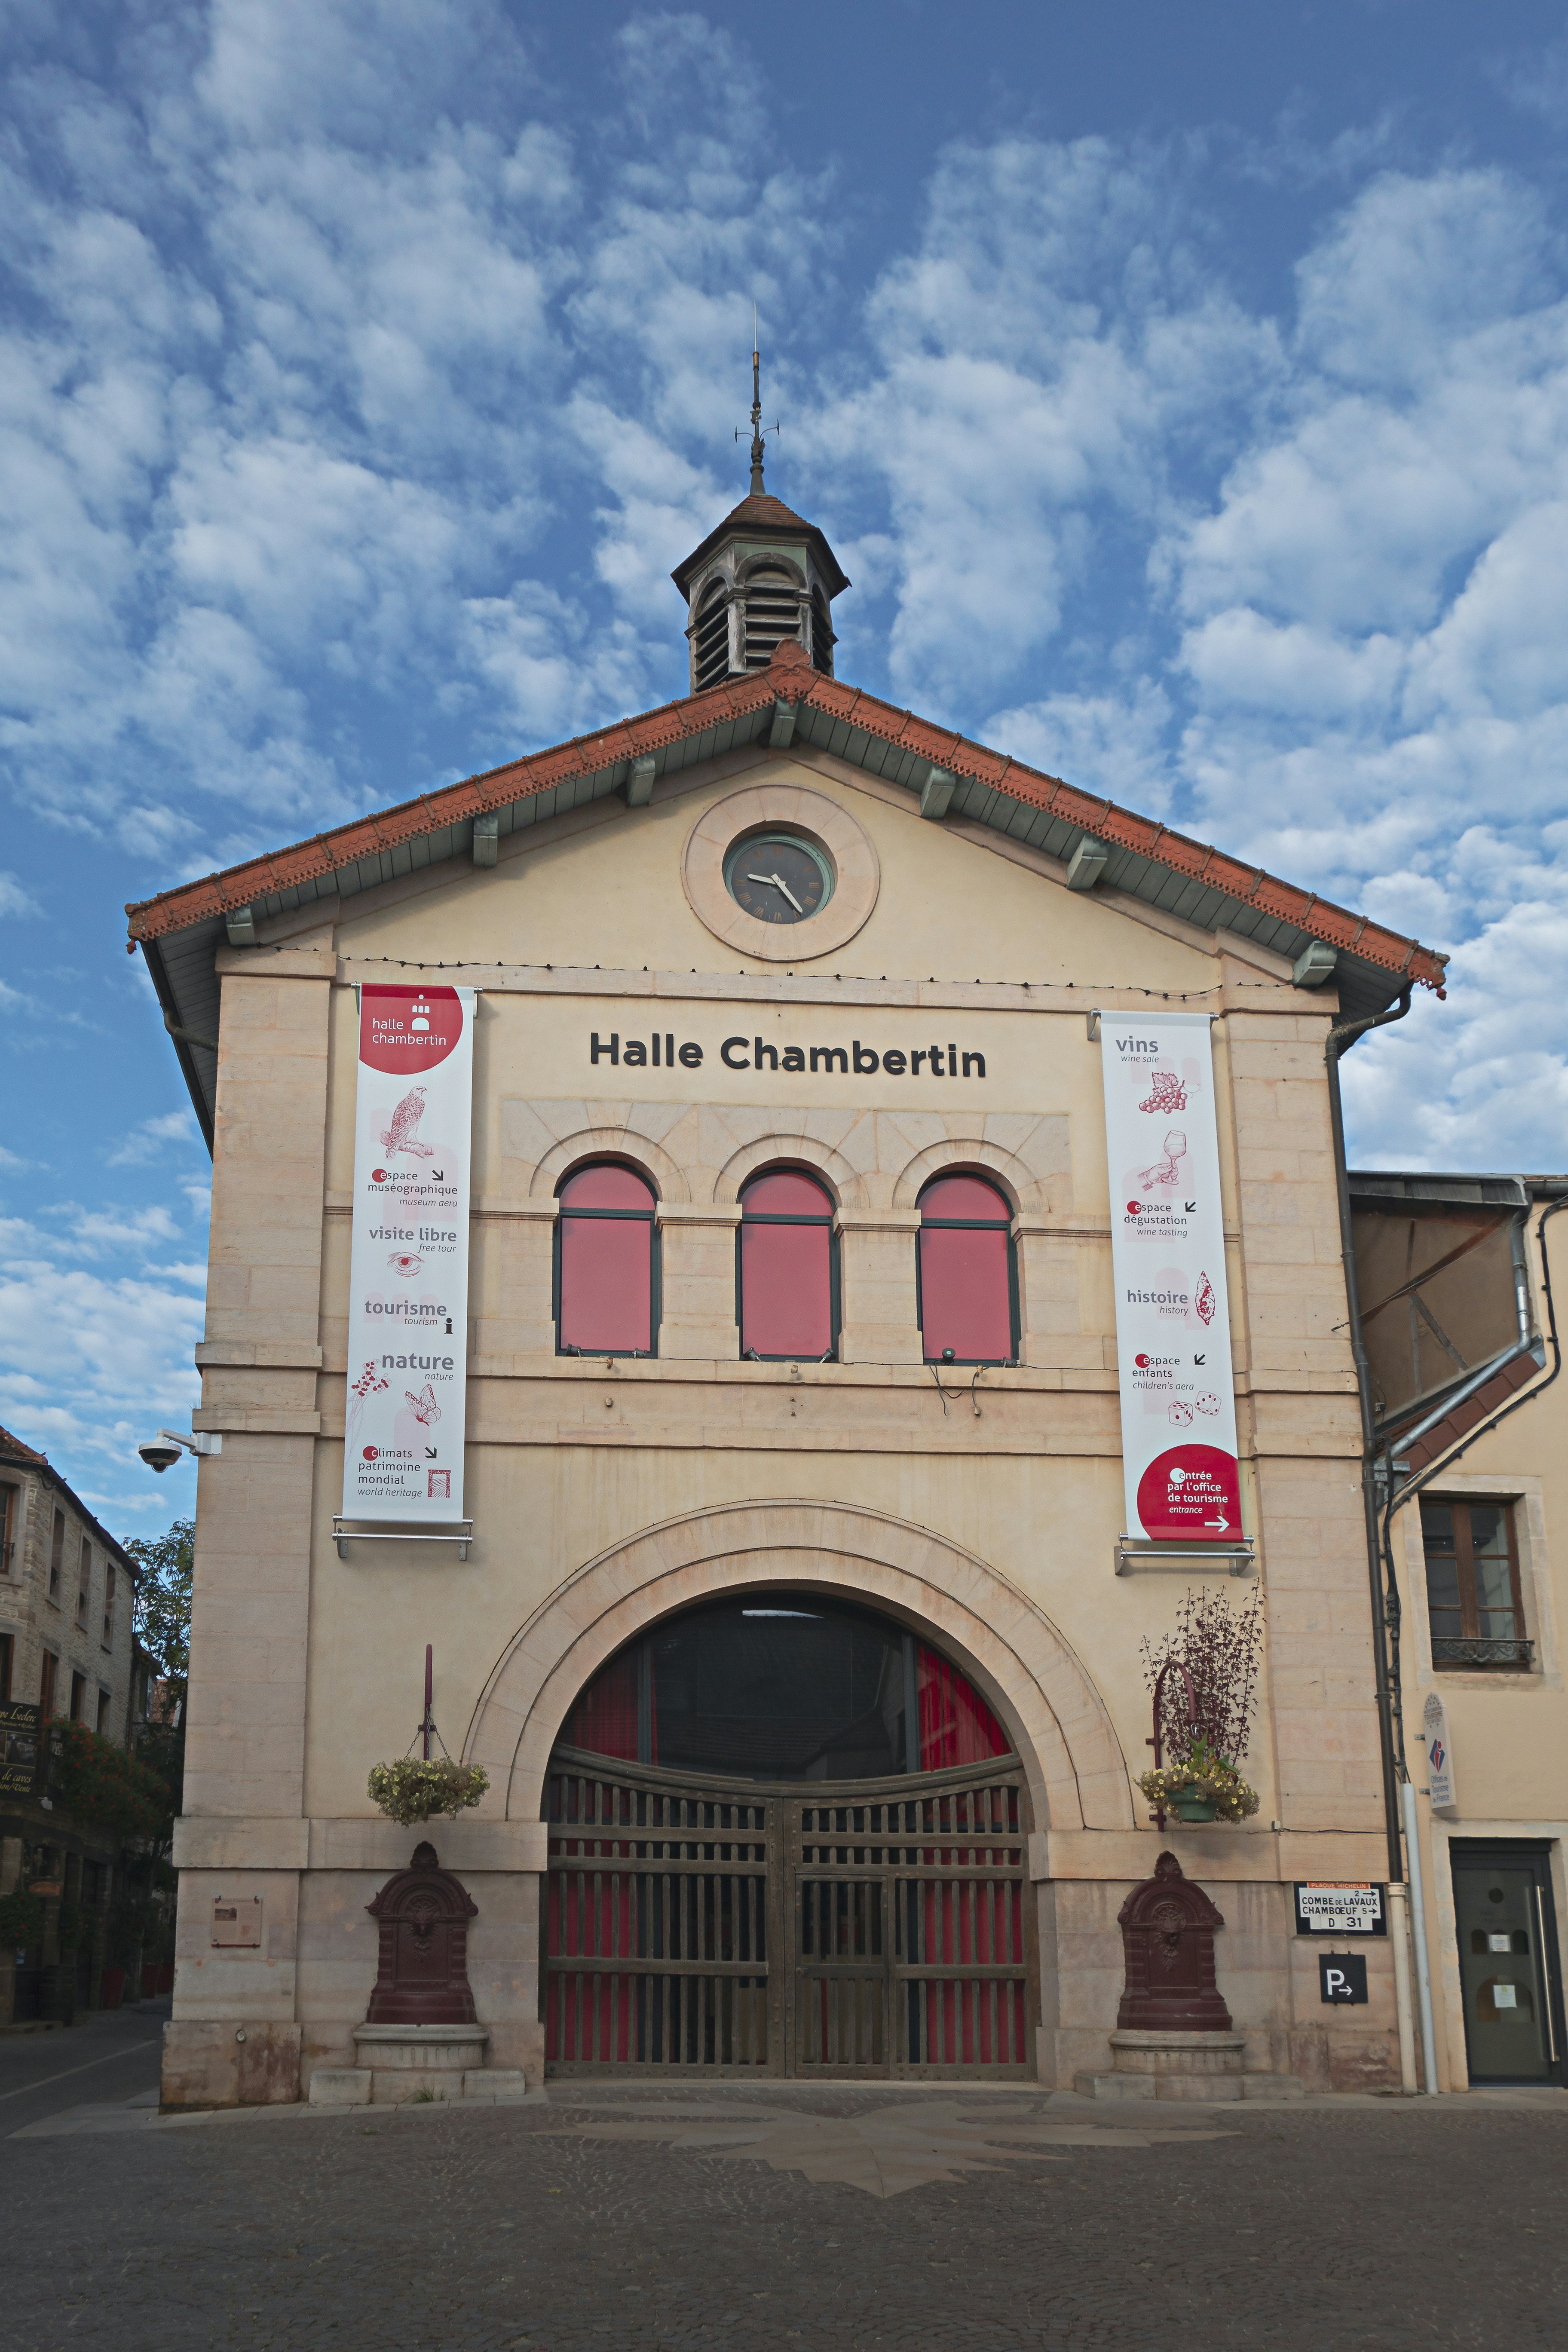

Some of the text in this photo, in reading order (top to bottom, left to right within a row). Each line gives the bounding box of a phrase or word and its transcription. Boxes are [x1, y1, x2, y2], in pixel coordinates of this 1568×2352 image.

[753, 906, 764, 918] VII
[774, 912, 782, 922] VI
[372, 1018, 404, 1030] halle
[372, 1032, 447, 1046] chambertin
[1115, 1036, 1158, 1053] vins
[590, 1032, 986, 1078] Halle Chambertin
[380, 1171, 418, 1182] espace
[368, 1183, 458, 1196] muséographique
[1135, 1204, 1171, 1213] espace
[1124, 1214, 1187, 1225] dégustation
[369, 1226, 457, 1241] visite libre
[1159, 1228, 1188, 1238] tasting
[418, 1243, 436, 1253] free
[1127, 1289, 1188, 1304] histoire
[365, 1300, 447, 1316] tourisme
[1160, 1306, 1188, 1316] history
[404, 1317, 438, 1326] tourism
[382, 1353, 454, 1370] nature
[1143, 1357, 1180, 1366] espace
[425, 1372, 453, 1381] nature
[1132, 1368, 1172, 1377] enfants
[1133, 1381, 1173, 1390] children's
[371, 1448, 412, 1458] climats
[358, 1462, 421, 1472] patrimoine
[358, 1475, 404, 1485] mondial
[1179, 1471, 1212, 1480] entrée
[1167, 1482, 1221, 1492] par l'office
[358, 1488, 422, 1498] world heritage
[1168, 1494, 1228, 1503] de tourisme
[10, 1706, 37, 1722] Leclerc
[2, 1768, 32, 1783] de caves
[1431, 1775, 1443, 1784] Offices
[1432, 1784, 1449, 1793] Tourisme
[1437, 1794, 1449, 1802] France
[1344, 1898, 1378, 1906] LAVAUX
[1303, 1907, 1357, 1915] CHAMBŒUF
[1329, 1917, 1362, 1927] D 31
[1326, 1969, 1344, 1995] P
